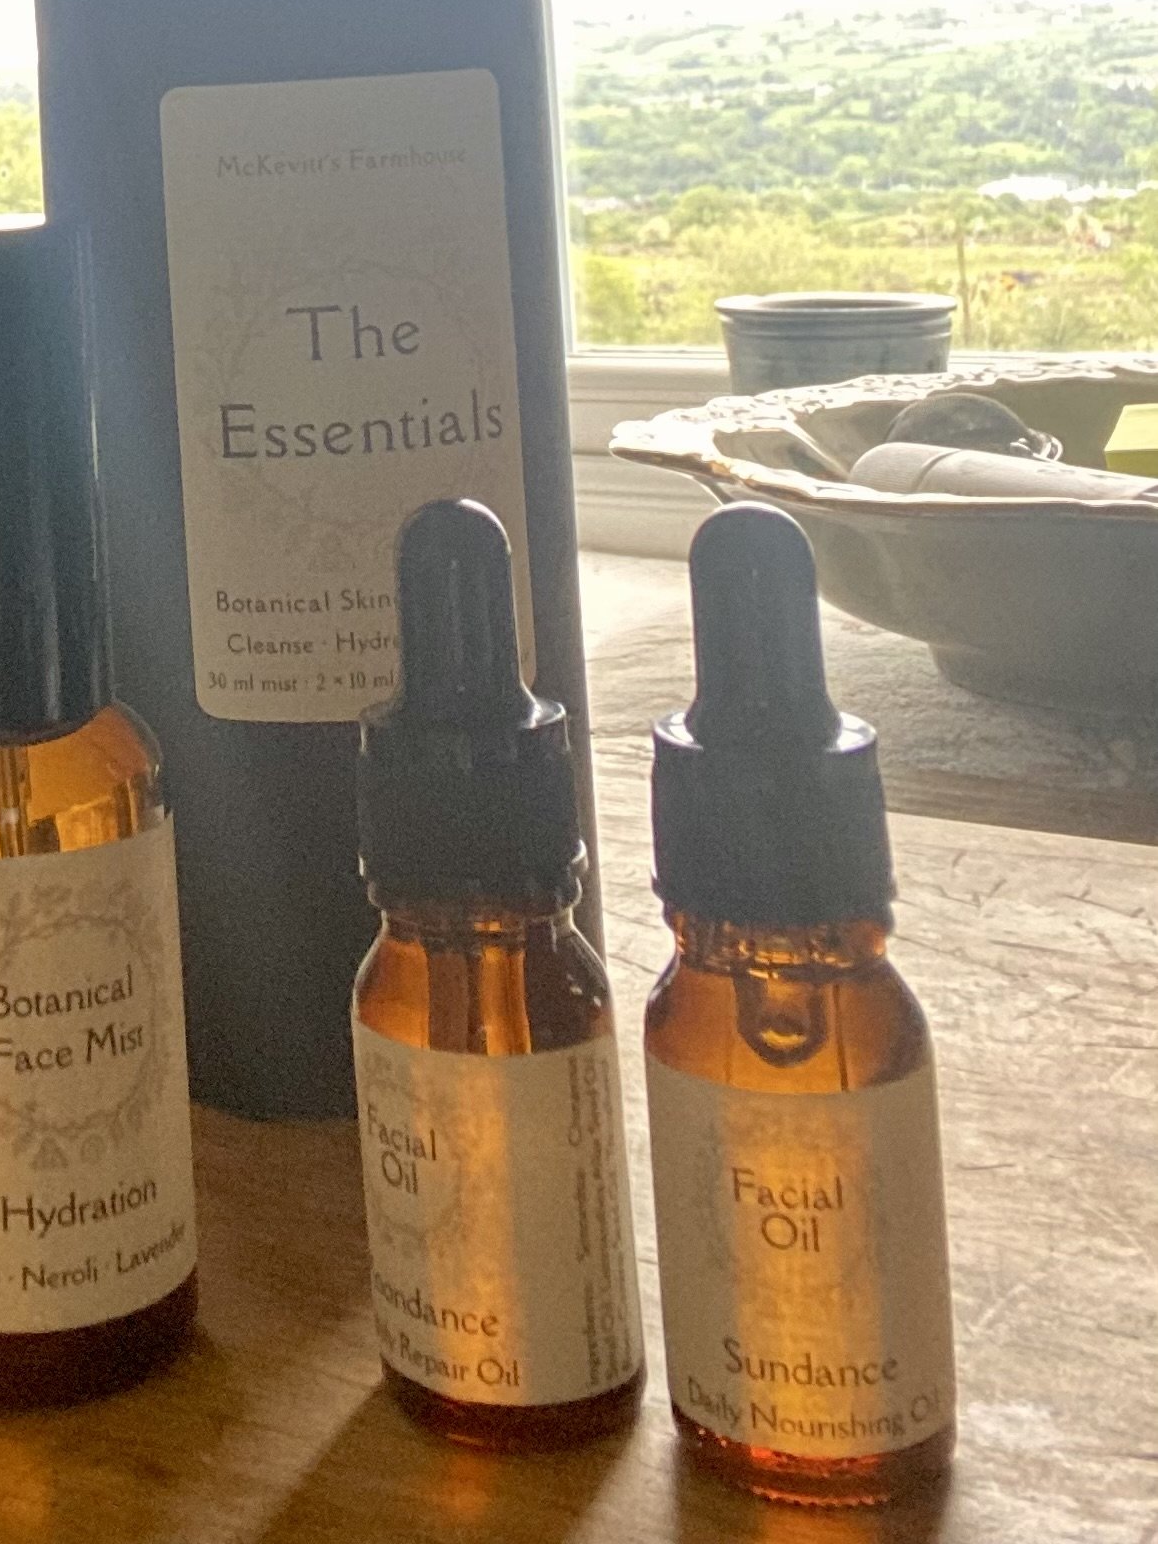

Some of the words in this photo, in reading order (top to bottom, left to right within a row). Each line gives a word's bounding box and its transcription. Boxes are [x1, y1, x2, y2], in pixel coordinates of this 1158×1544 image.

[286, 305, 419, 360] The
[220, 389, 503, 458] Essentials
[216, 590, 329, 614] Botanical
[227, 633, 313, 655] Cleanse
[208, 671, 227, 689] 30
[233, 673, 254, 691] ml
[316, 673, 326, 691] 2
[349, 671, 367, 689] 10
[86, 1022, 144, 1064] Mist
[367, 1103, 437, 1161] Facial
[381, 1151, 419, 1194] Oil
[731, 1167, 844, 1211] Facial
[1, 1178, 157, 1239] Hydration
[760, 1213, 821, 1253] Oil
[22, 1258, 98, 1291] Neroli
[399, 1331, 470, 1382] Repair
[476, 1358, 520, 1387] Oil
[723, 1335, 899, 1388] Sundance
[687, 1375, 741, 1426] Daily
[749, 1402, 907, 1440] Nourishing
